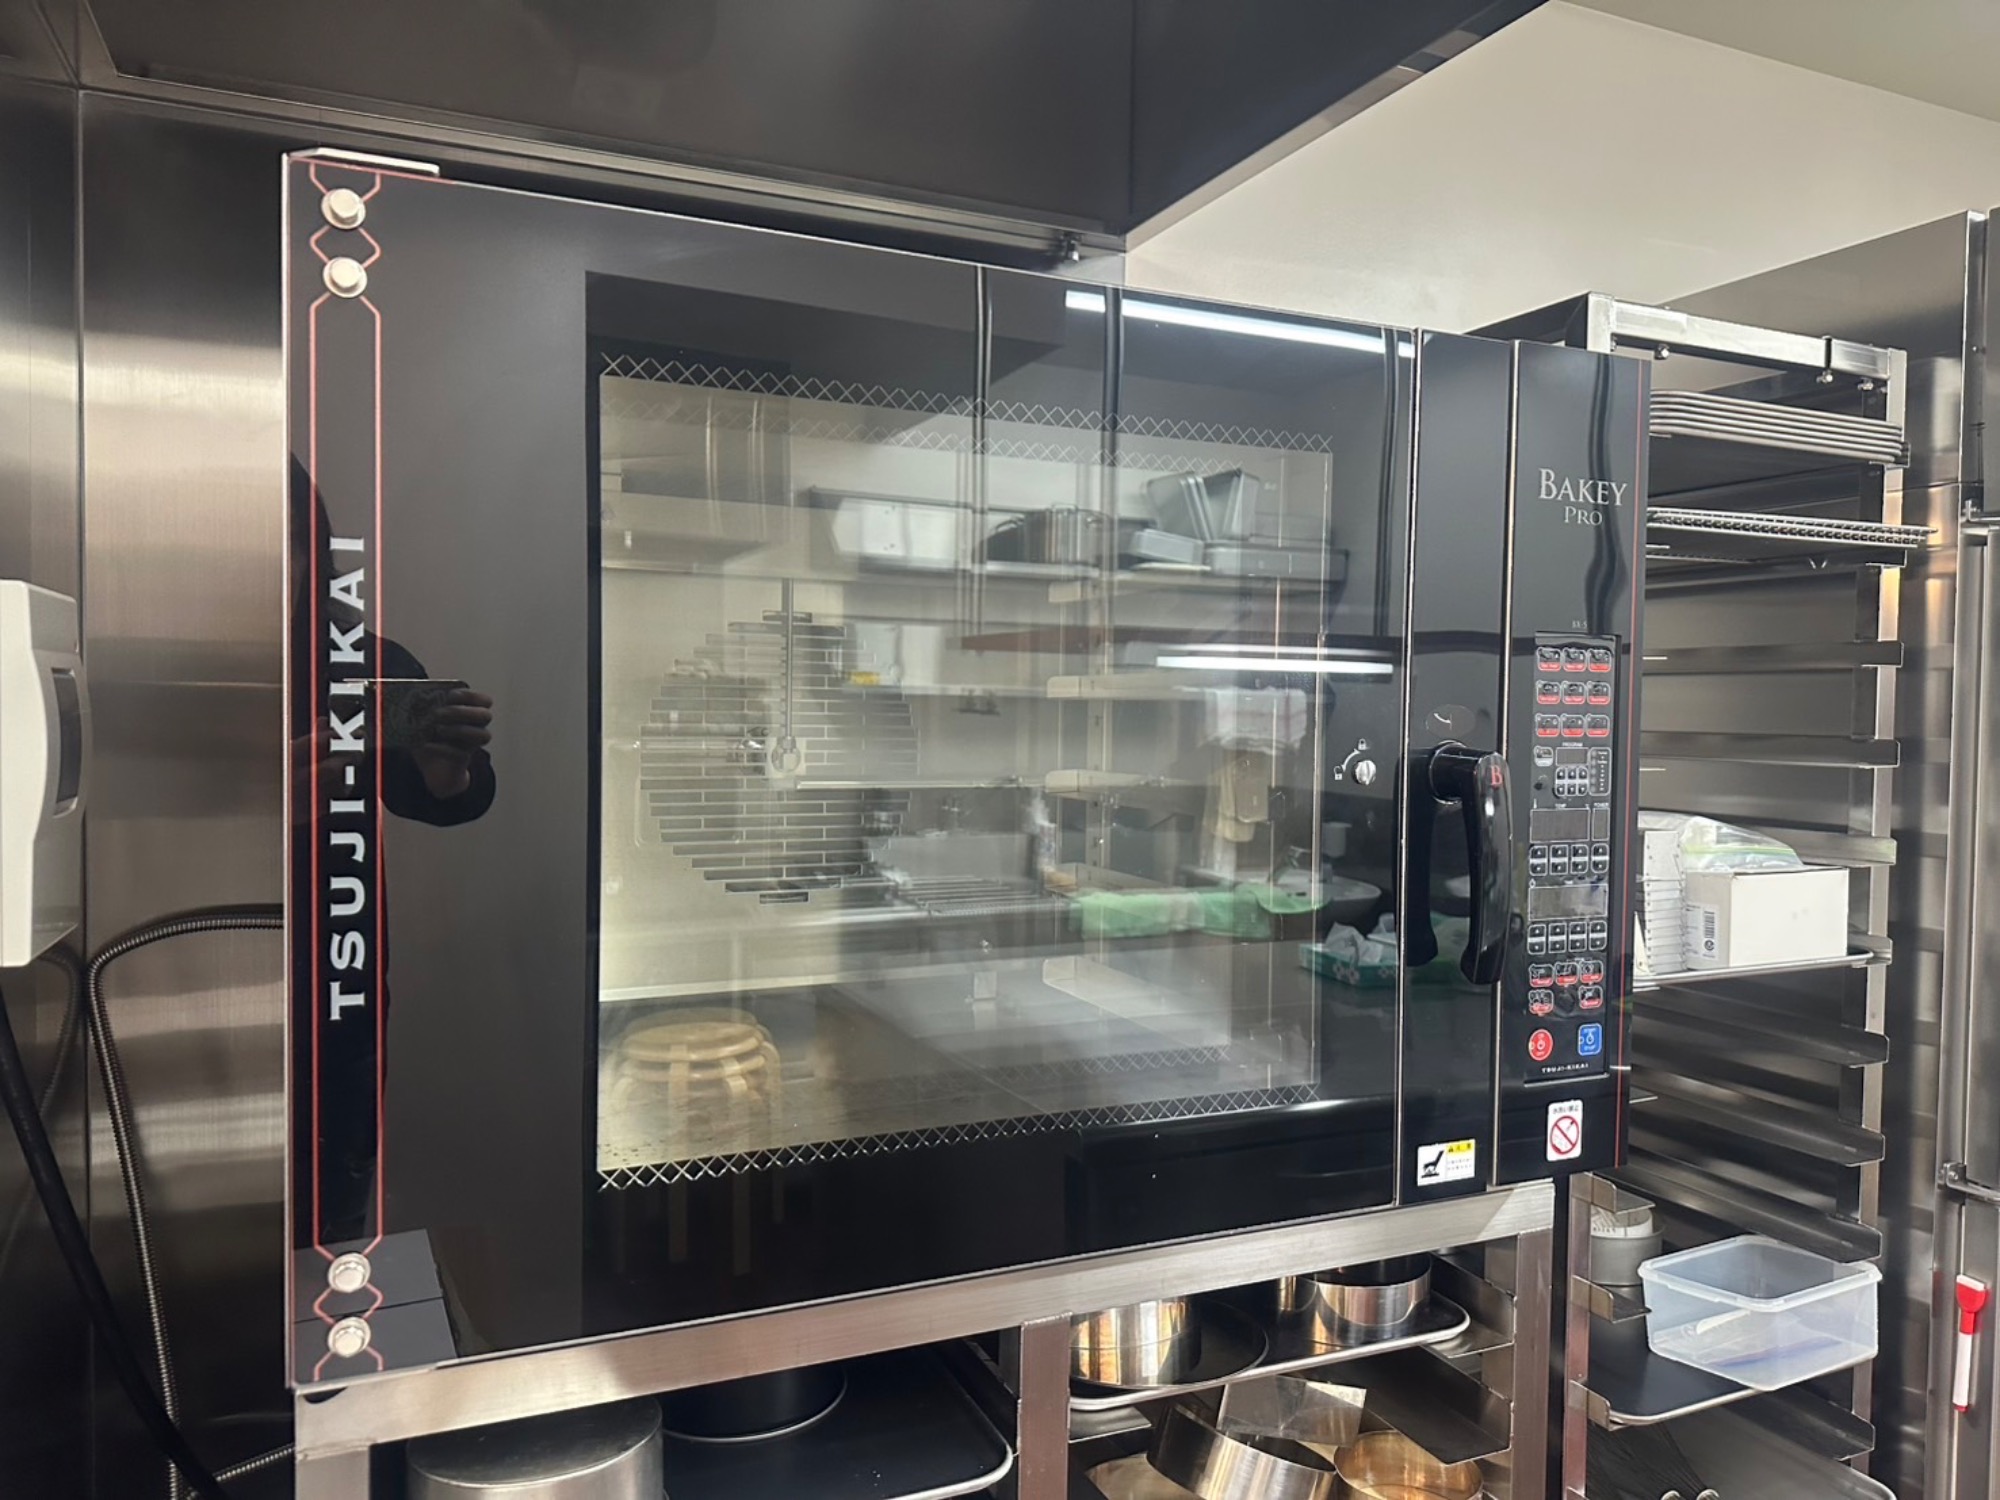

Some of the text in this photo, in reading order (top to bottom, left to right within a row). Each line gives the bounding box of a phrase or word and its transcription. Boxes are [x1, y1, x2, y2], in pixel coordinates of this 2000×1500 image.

[1538, 467, 1628, 506] BAKEY
[1564, 505, 1603, 526] PRO
[329, 536, 365, 1021] TSUJI-KIKAI
